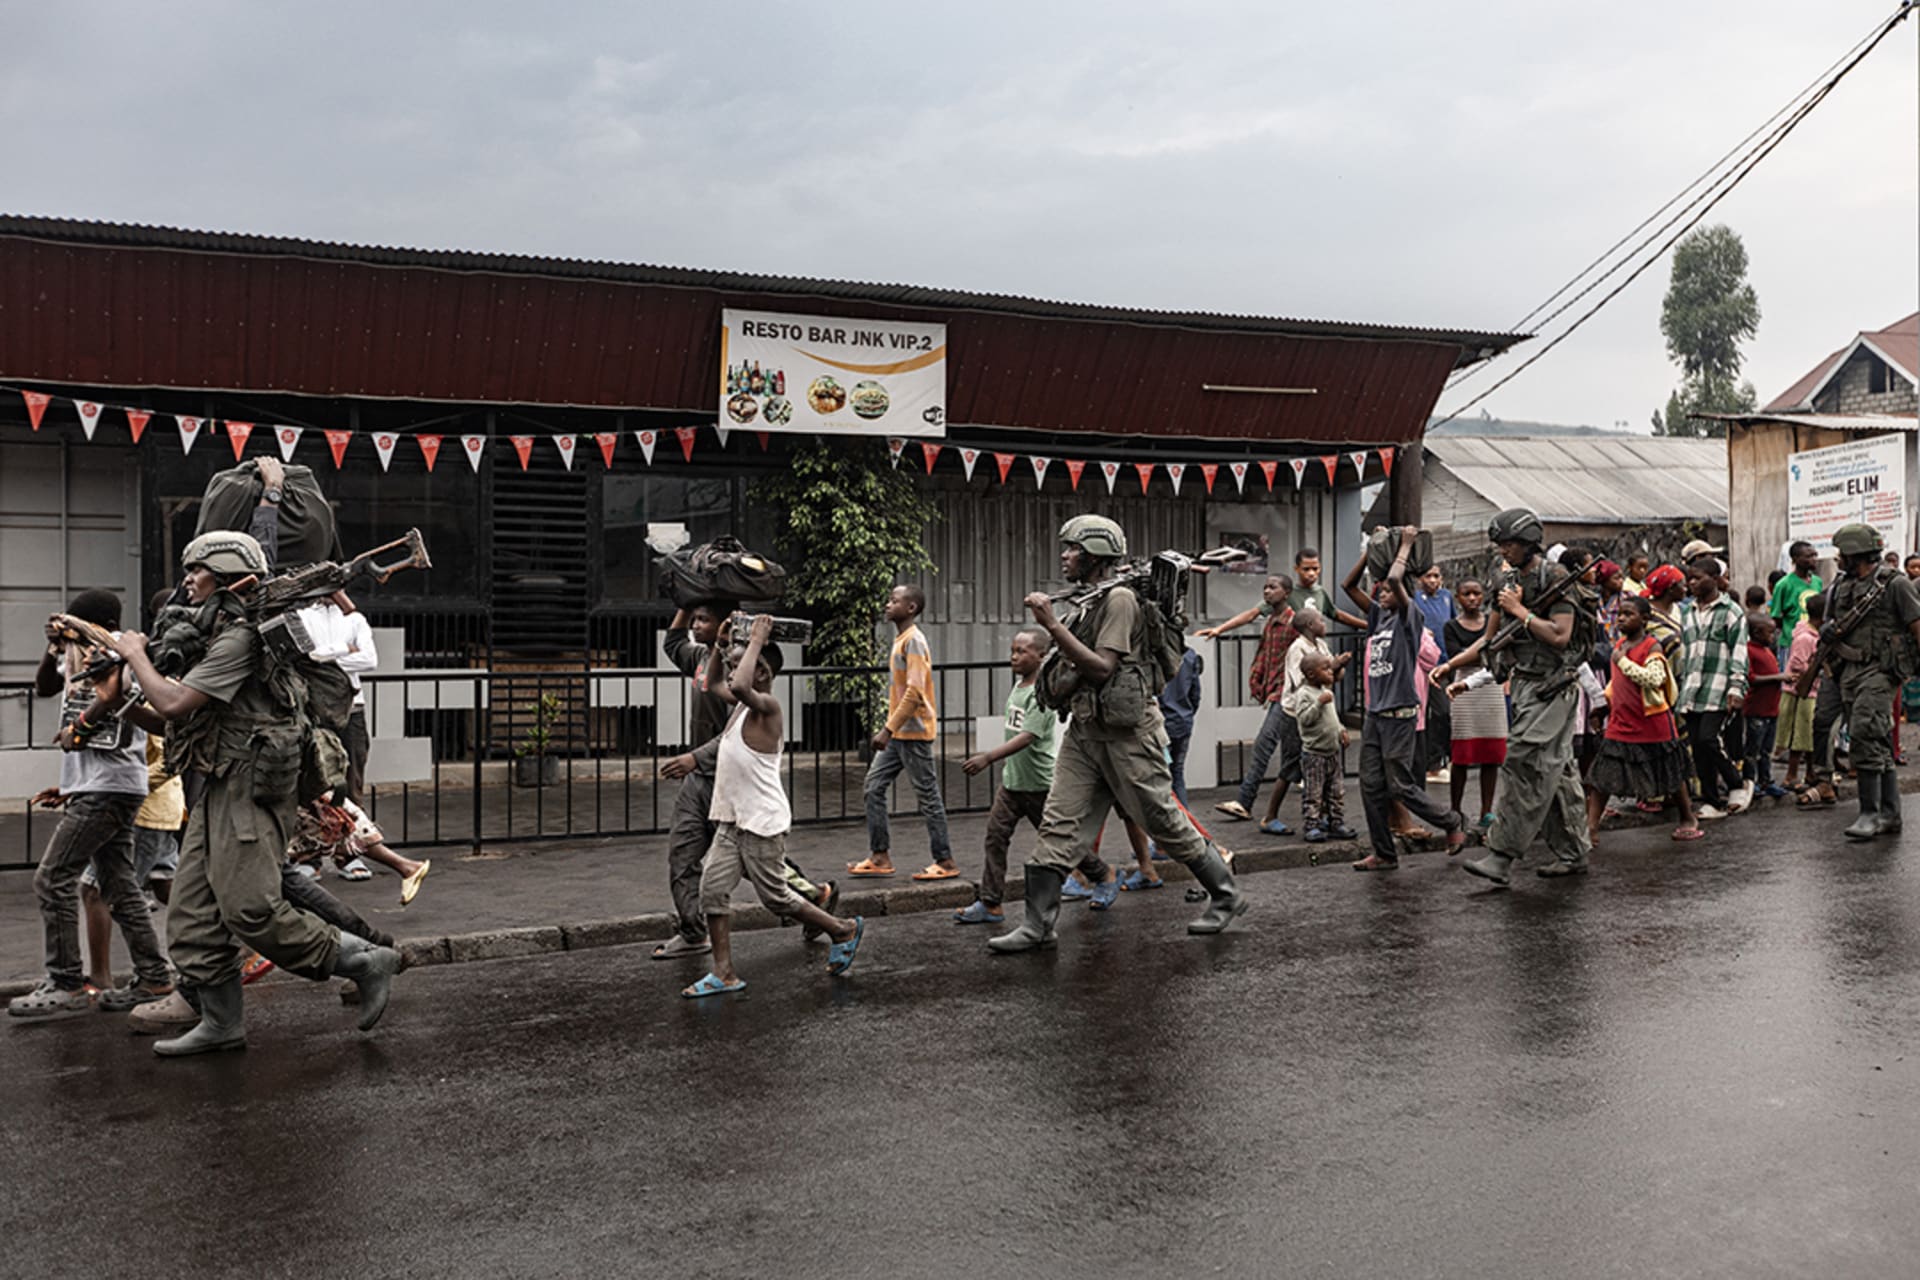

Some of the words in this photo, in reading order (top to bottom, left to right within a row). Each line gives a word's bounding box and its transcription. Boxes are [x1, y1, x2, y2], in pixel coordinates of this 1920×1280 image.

[742, 320, 803, 340] RESTO
[808, 327, 846, 345] BAR
[851, 331, 885, 348] JNK
[889, 333, 932, 351] VIP.2
[1847, 475, 1879, 495] ELIM
